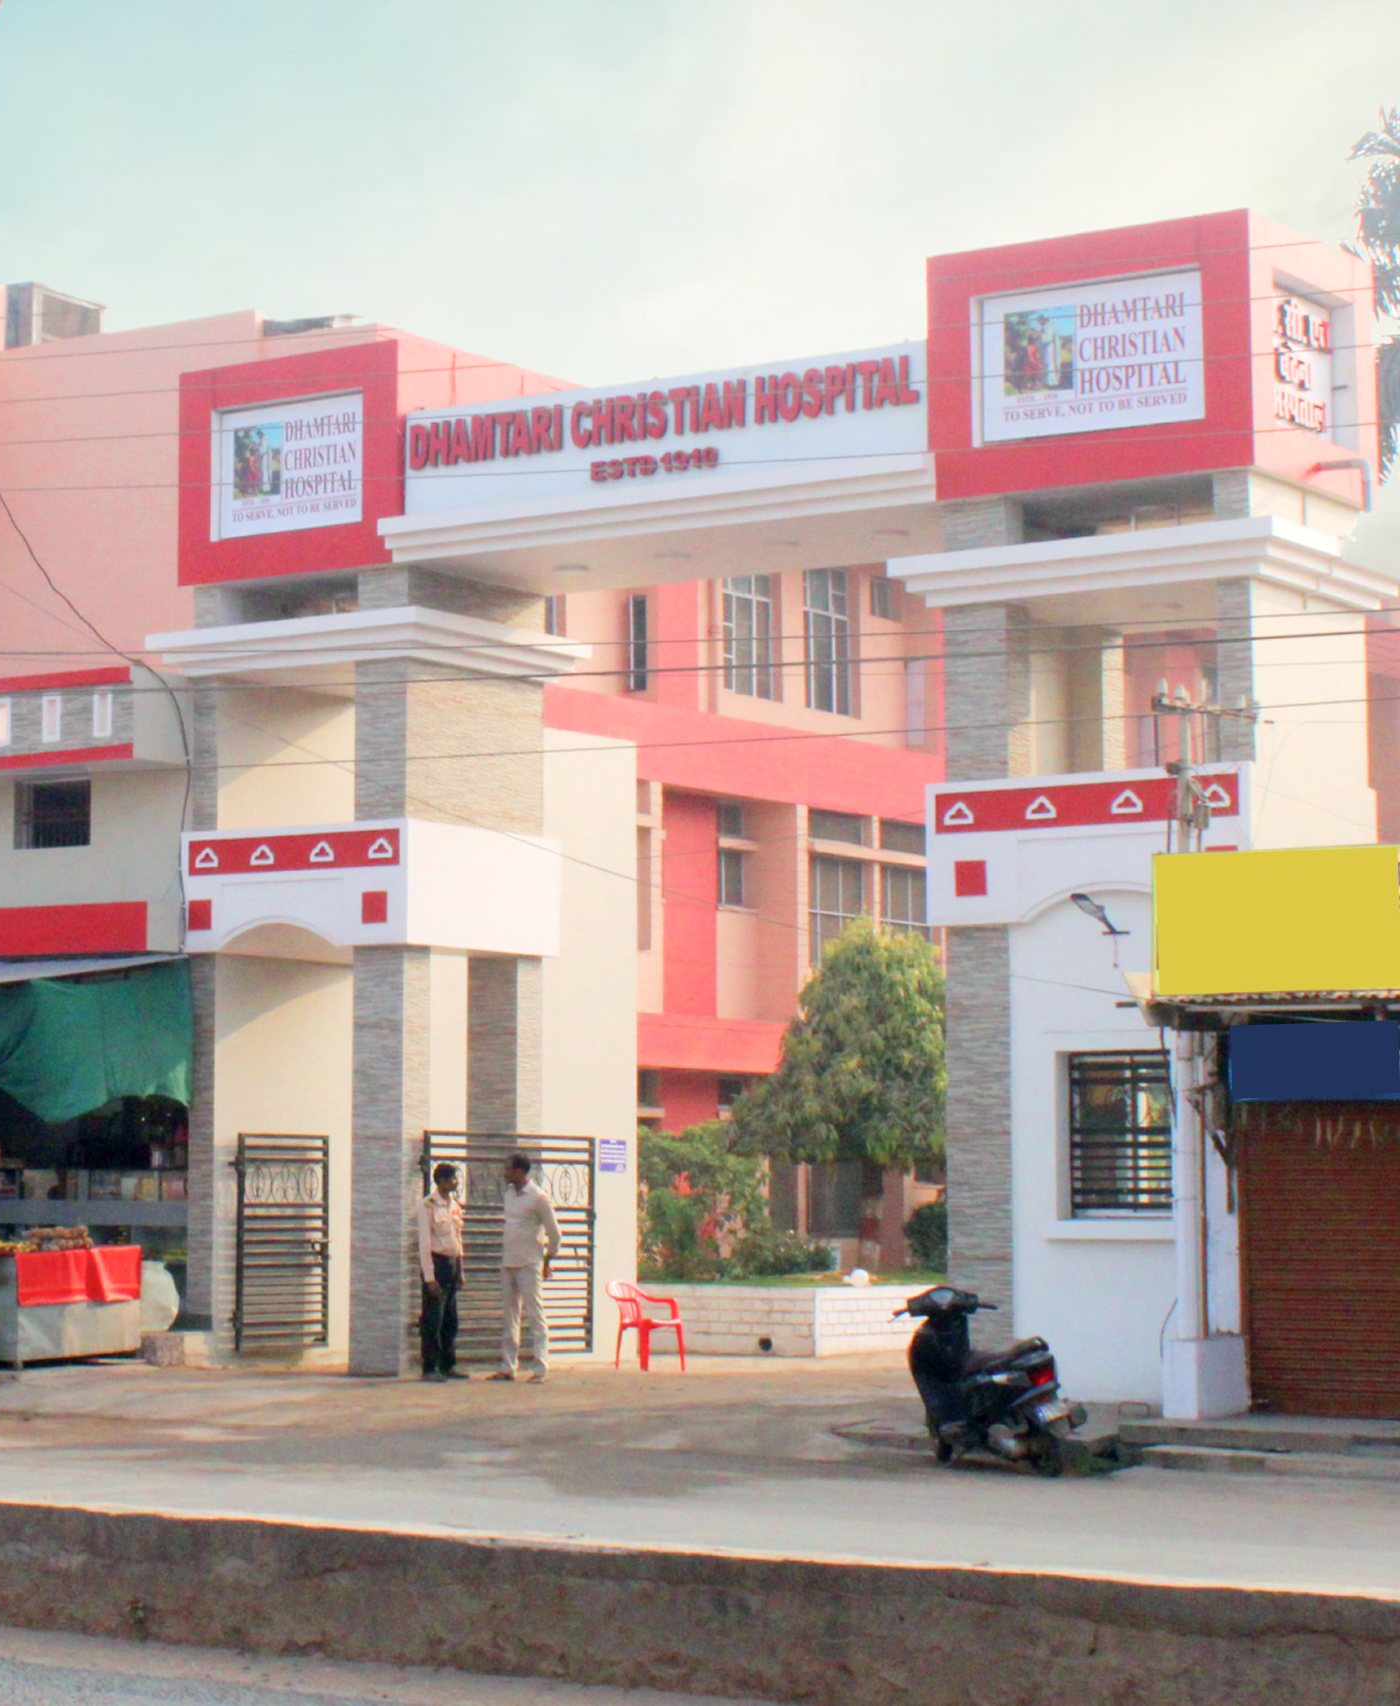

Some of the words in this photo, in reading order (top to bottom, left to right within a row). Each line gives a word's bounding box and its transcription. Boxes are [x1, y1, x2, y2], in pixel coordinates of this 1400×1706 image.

[1079, 292, 1185, 329] DHAMTARI
[1078, 326, 1186, 363] CHRISTIAN
[1079, 361, 1187, 395] HOSPITAL
[408, 403, 564, 472] DHAMTARI
[570, 377, 747, 450] CHRISTIAN
[753, 354, 919, 426] HOSPITAL
[1003, 410, 1020, 423] TO
[1022, 406, 1066, 421] SERVE,
[1068, 402, 1093, 416] NOT
[1097, 399, 1114, 413] TO
[1118, 397, 1133, 411] BE
[1136, 392, 1187, 409] SERVED
[285, 411, 356, 442] DHAMTARI
[284, 441, 357, 472] CHRISTIAN
[589, 454, 658, 482] ESTD
[659, 446, 719, 473] 1910
[284, 470, 357, 499] HOSPITAL
[232, 512, 244, 523] TO
[245, 508, 275, 521] SERVE,
[276, 505, 294, 517] NOT
[297, 504, 308, 515] TO
[310, 502, 321, 513] BE
[323, 498, 357, 512] SERVED
